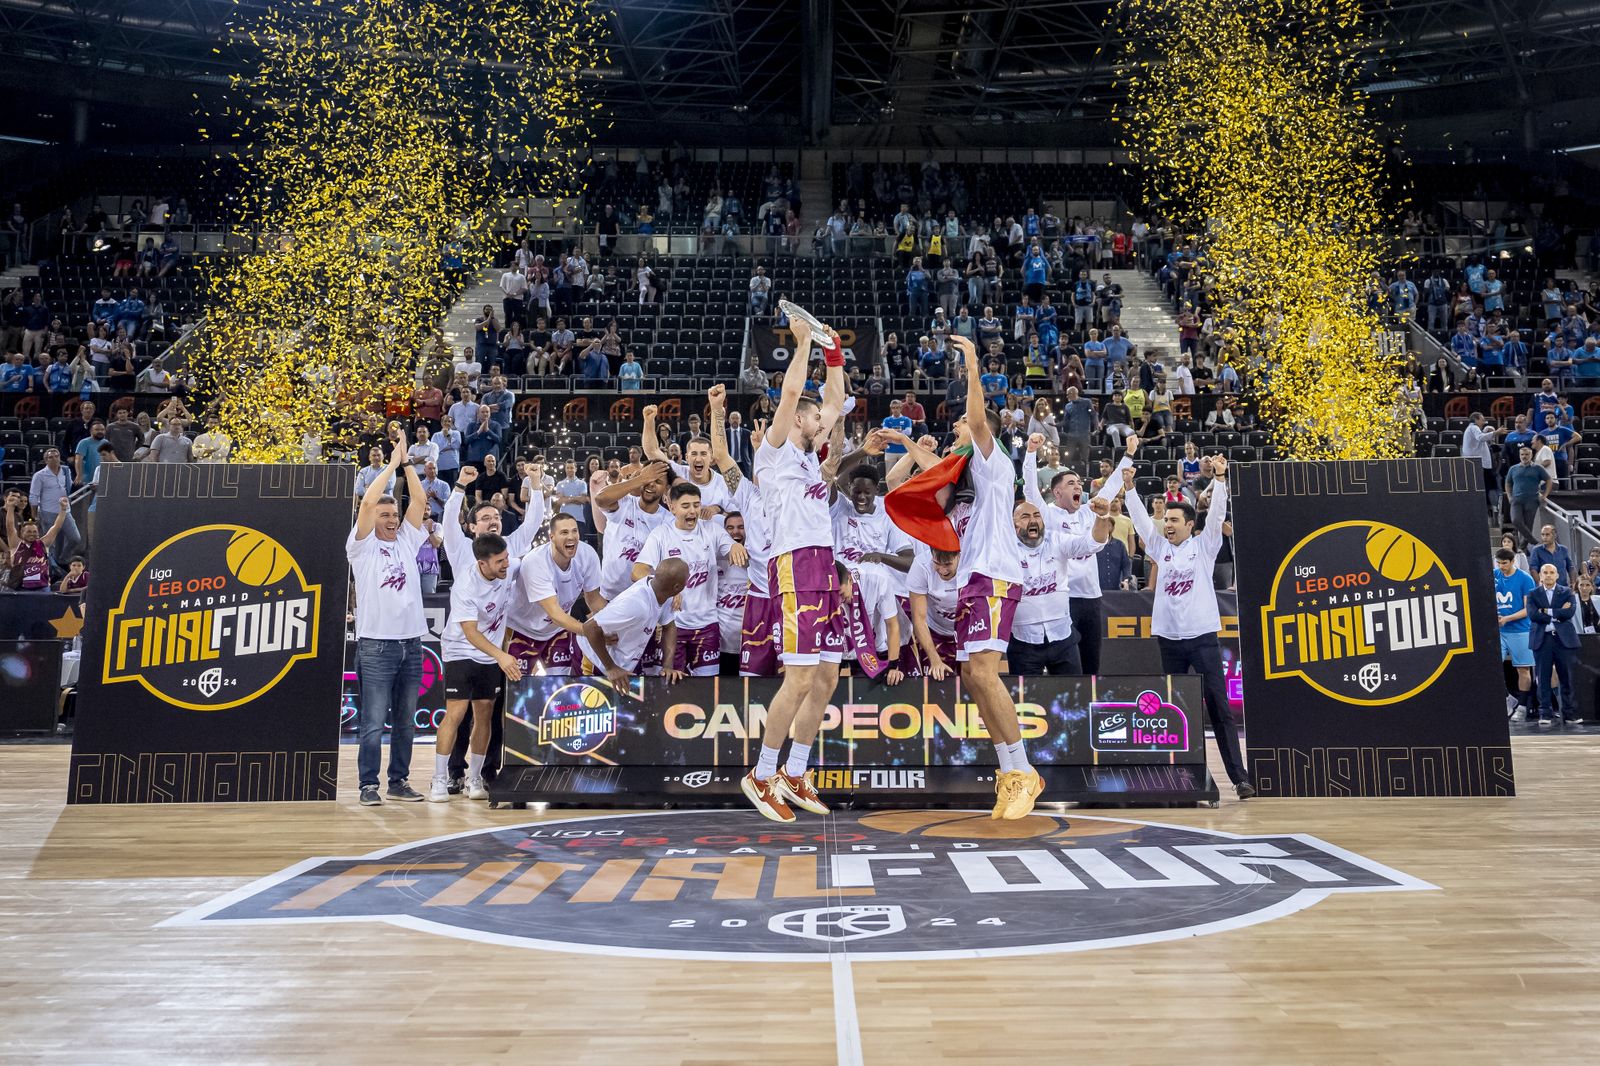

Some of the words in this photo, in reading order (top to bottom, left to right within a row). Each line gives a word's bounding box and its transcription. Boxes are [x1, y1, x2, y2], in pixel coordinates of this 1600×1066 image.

[150, 567, 172, 581] Liga
[1294, 564, 1316, 578] Liga
[148, 581, 182, 598] LEB
[186, 575, 226, 593] ORO
[1295, 577, 1329, 594] LEB
[1332, 572, 1371, 588] ORO
[180, 592, 249, 608] MADRID
[1329, 587, 1395, 604] MADRID
[182, 678, 196, 686] 20
[223, 678, 237, 686] 24
[1383, 673, 1397, 681] 24
[1132, 712, 1168, 729] força
[1133, 729, 1179, 744] lleida
[514, 837, 669, 850] LEB
[694, 832, 866, 845] ORO
[530, 829, 624, 839] Liga
[665, 843, 979, 855] MADRID
[667, 918, 748, 928] 20
[931, 917, 1006, 926] 24
